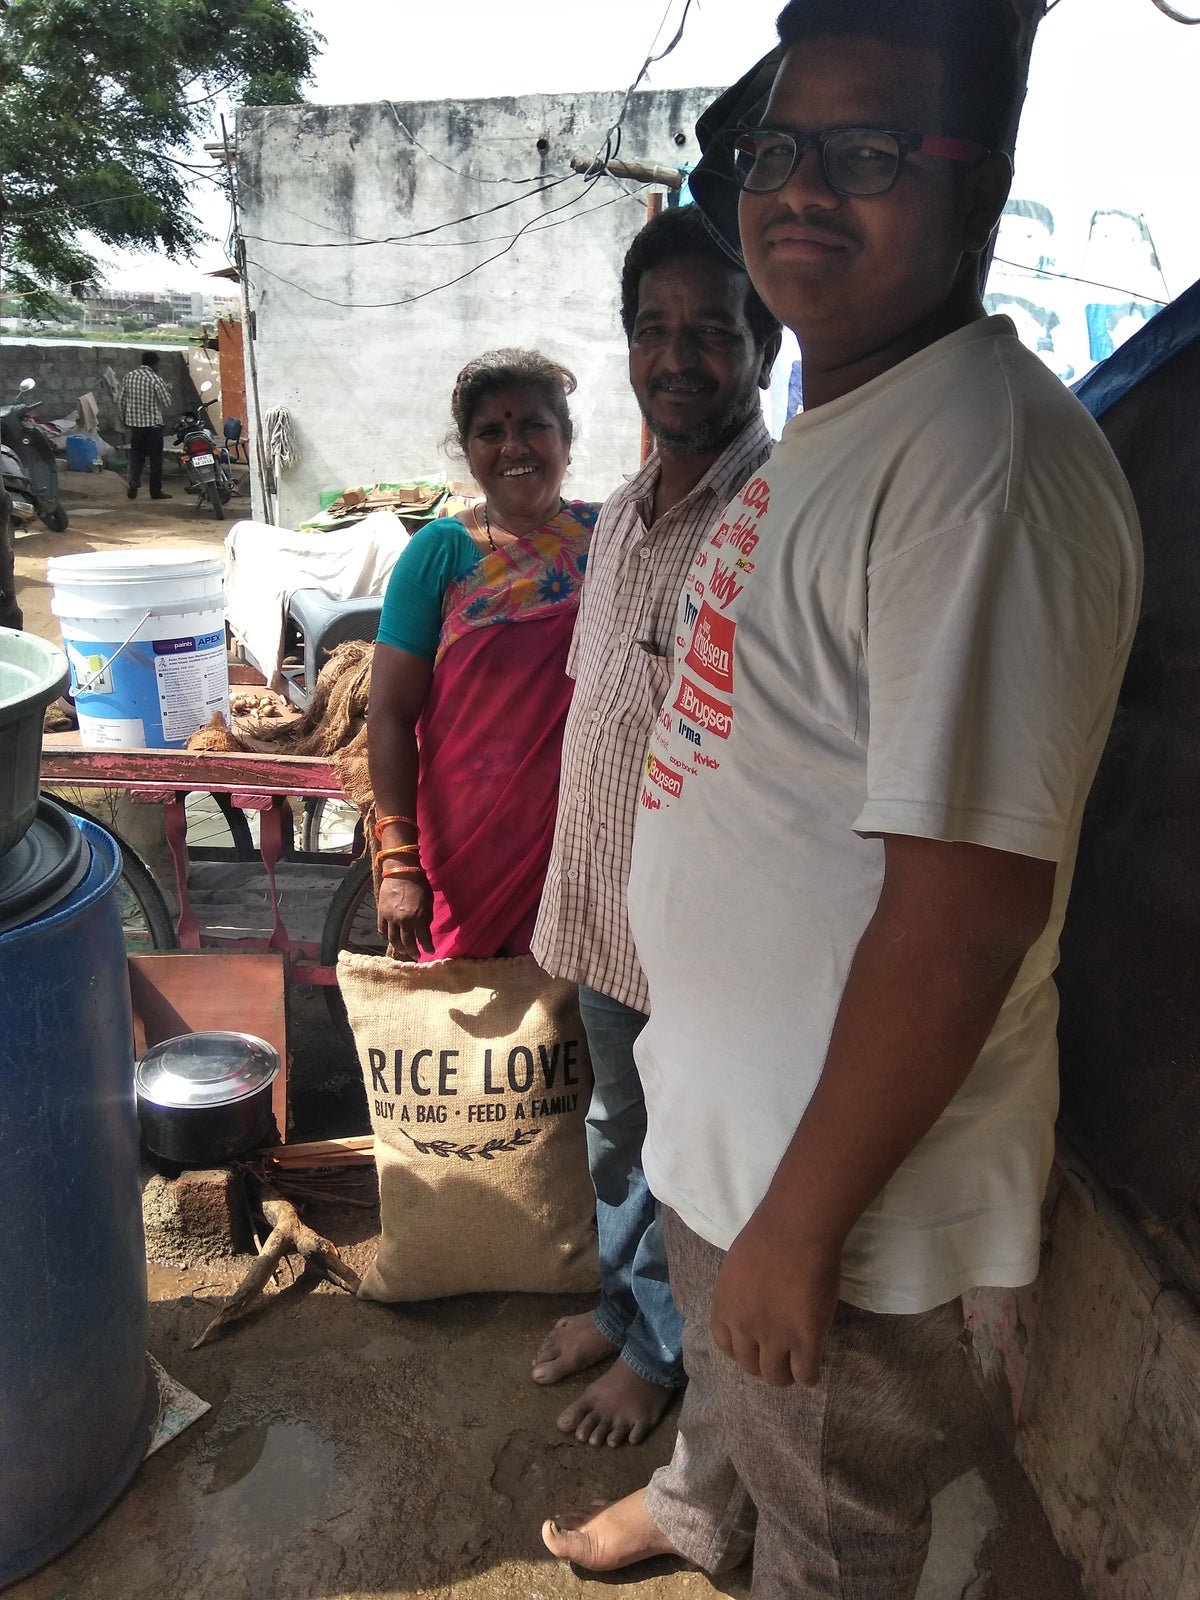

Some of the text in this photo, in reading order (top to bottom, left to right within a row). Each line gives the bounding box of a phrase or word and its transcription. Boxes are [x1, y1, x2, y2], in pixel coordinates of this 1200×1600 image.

[174, 641, 193, 651] paints
[198, 634, 221, 646] APEX
[685, 686, 733, 735] Brugsen
[678, 718, 702, 747] Irma
[368, 1040, 579, 1096] RICE LOVE
[374, 1095, 579, 1124] BUY A BAG FEED A FAMILY
